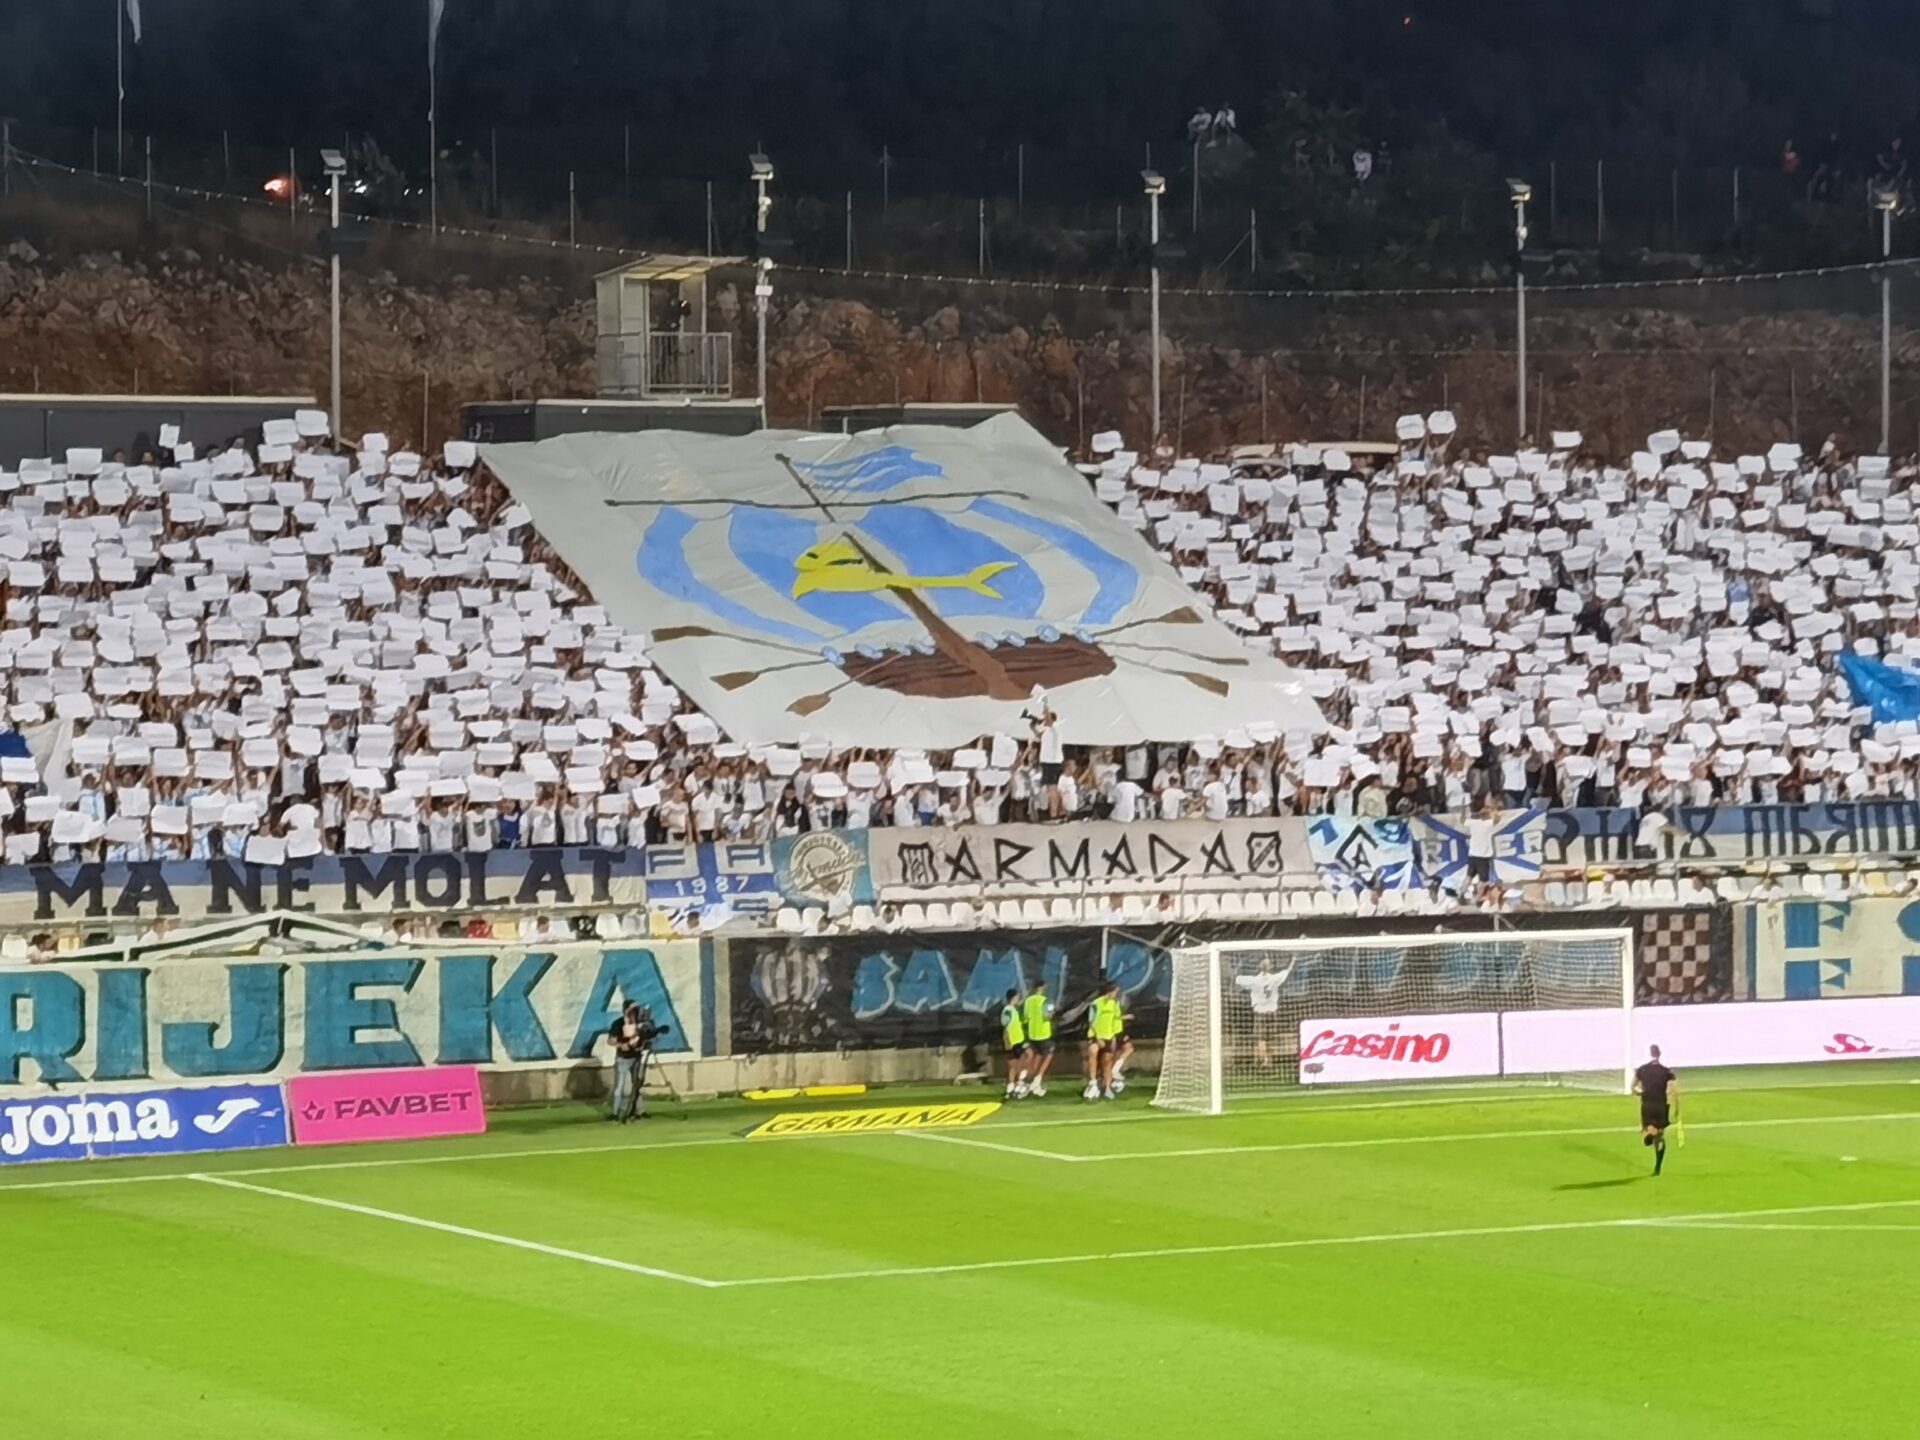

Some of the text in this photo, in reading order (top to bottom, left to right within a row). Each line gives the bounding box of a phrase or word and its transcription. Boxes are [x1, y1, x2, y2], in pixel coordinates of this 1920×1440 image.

[945, 829, 1236, 887] ARMADA
[1420, 830, 1543, 866] RIER
[29, 849, 626, 919] MA NE MOLAT
[675, 875, 749, 896] 1987
[0, 948, 692, 1083] RIJEKA
[1299, 1023, 1451, 1063] Casino
[335, 1091, 472, 1120] FAVBET
[766, 1108, 980, 1133] GERMANIA
